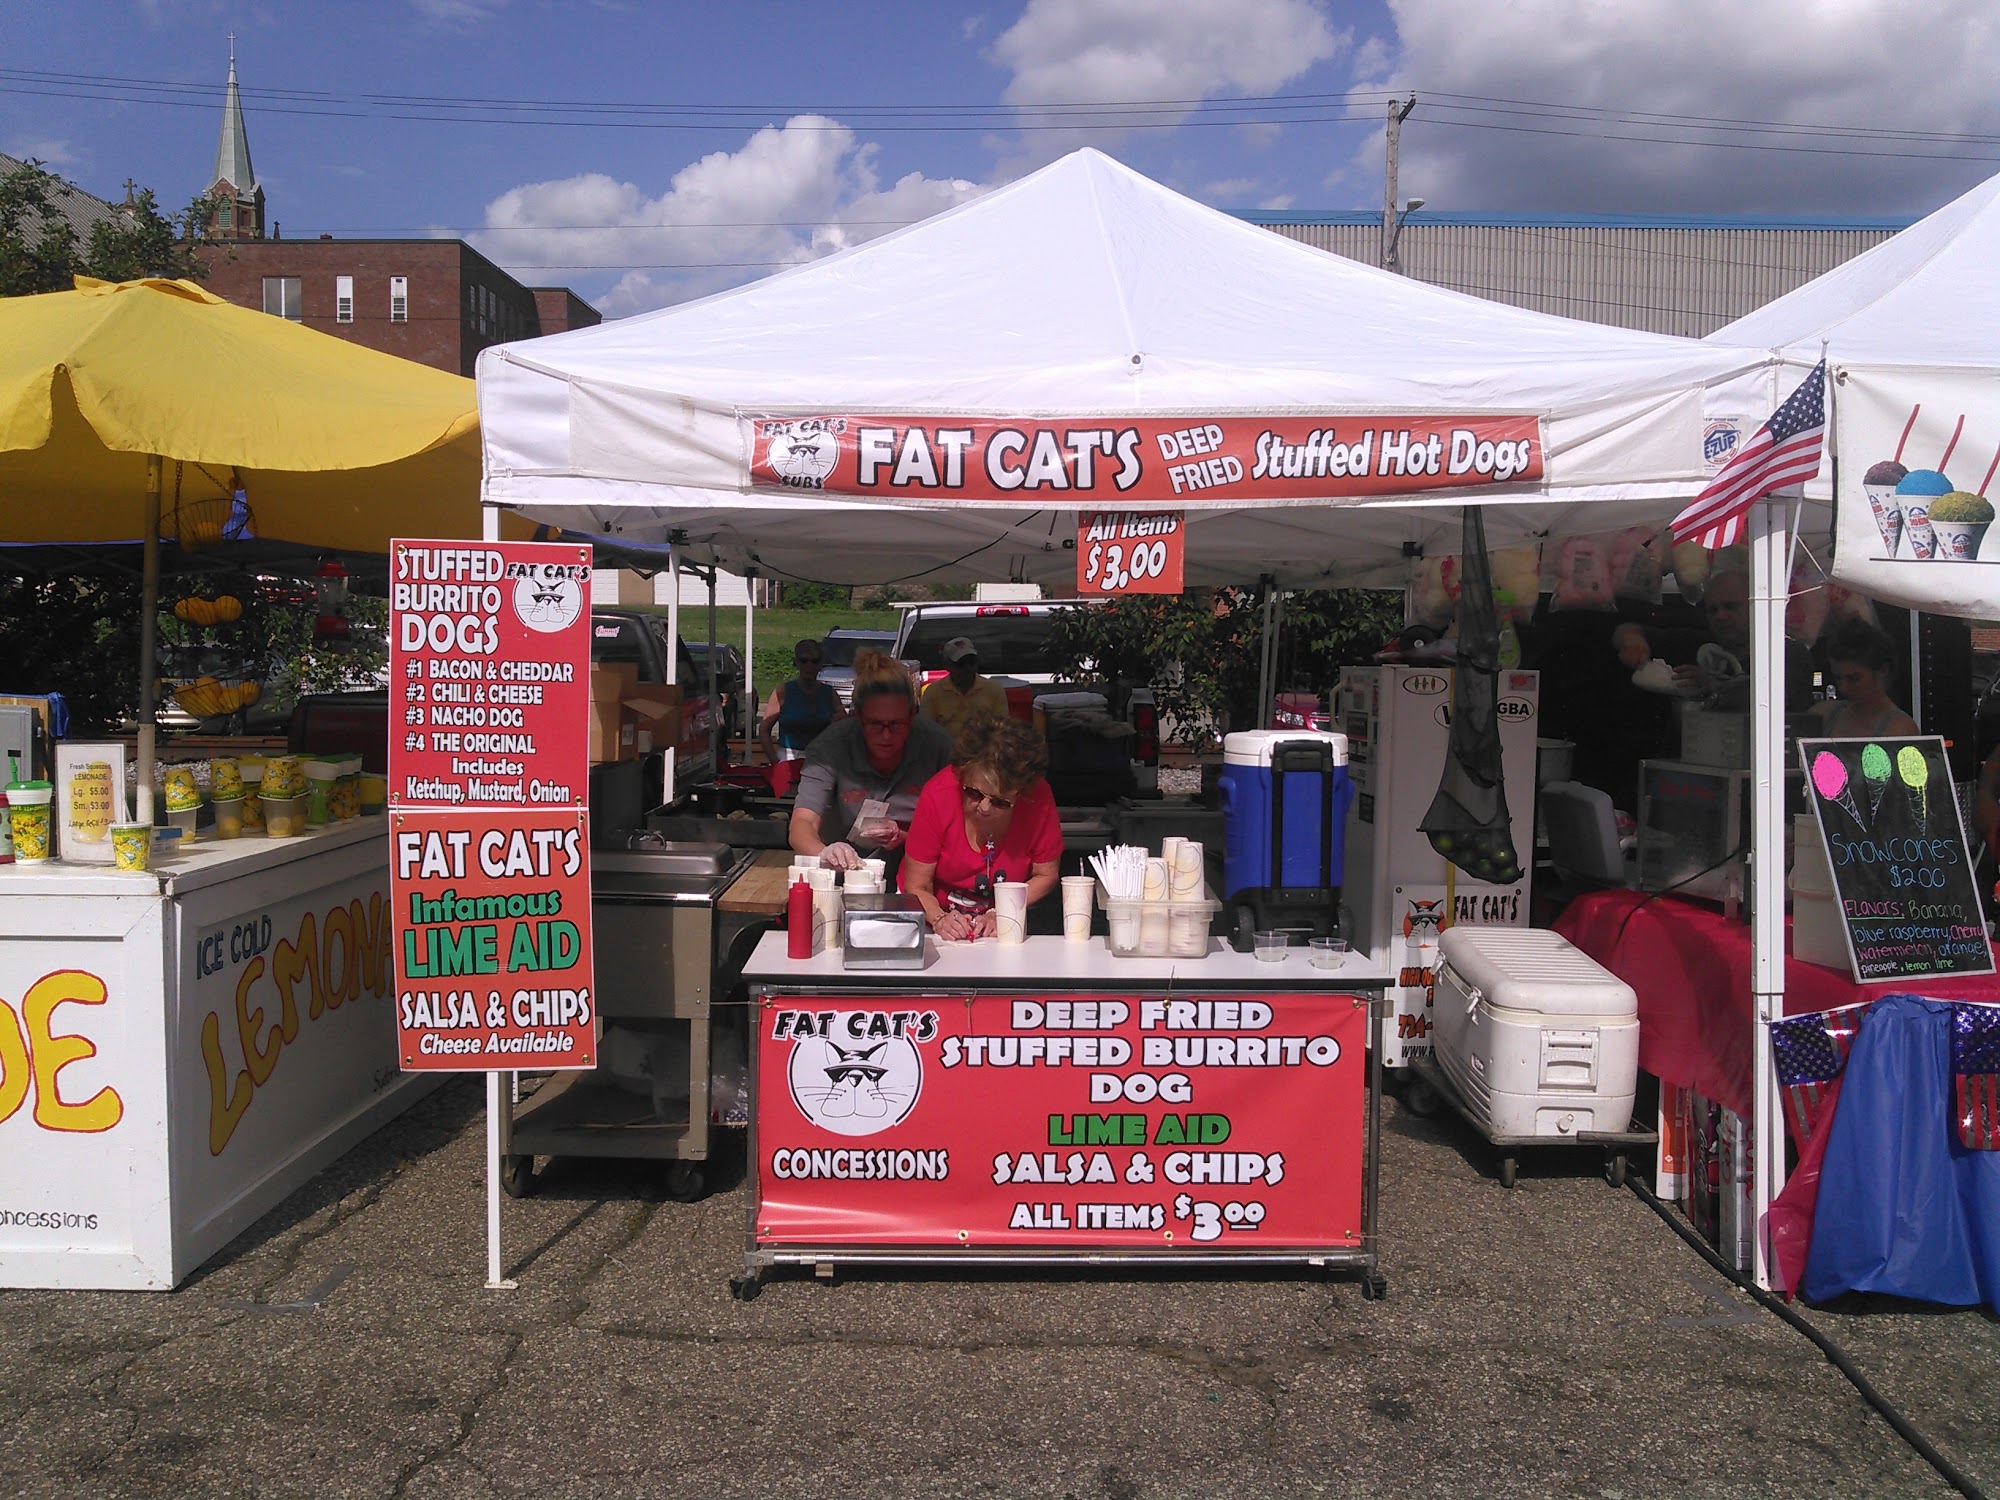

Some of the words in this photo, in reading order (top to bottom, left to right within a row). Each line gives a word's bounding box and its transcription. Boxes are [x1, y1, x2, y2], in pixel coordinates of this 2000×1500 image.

[763, 421, 794, 437] FAT
[800, 417, 848, 435] CAT'S
[1155, 423, 1224, 461] DEEP
[857, 427, 974, 488] FAT
[985, 427, 1142, 491] CAT'S
[1252, 428, 1374, 480] Stuffed
[1377, 429, 1442, 477] Hot
[1446, 429, 1530, 480] Dogs
[782, 475, 822, 489] SUBS
[1167, 455, 1243, 495] FRIED
[1085, 514, 1119, 542] All
[1120, 512, 1177, 539] Items
[398, 549, 504, 582] STUFFED
[507, 563, 537, 580] FAT
[543, 564, 591, 582] CAT'S
[394, 582, 502, 614] BURRITO
[401, 613, 499, 655] DOGS
[406, 659, 423, 679] #1
[429, 659, 482, 680] BACON
[485, 661, 497, 680] &
[500, 661, 574, 682] CHEDDAR
[405, 683, 425, 702] #2
[431, 683, 470, 703] CHILI
[474, 684, 485, 703] &
[488, 685, 543, 704] CHEESE
[1497, 702, 1530, 715] GBA
[405, 706, 424, 725] #3
[431, 706, 486, 726] NACHO
[489, 708, 523, 727] DOG
[405, 732, 425, 751] #4
[431, 732, 461, 752] THE
[464, 733, 537, 754] ORIGINAL
[452, 757, 524, 776] Includes
[89, 787, 109, 796] $5.00
[90, 801, 110, 810] $3.00
[406, 777, 465, 804] Ketchup,
[468, 778, 527, 804] Mustard,
[529, 779, 569, 803] Onion
[397, 830, 471, 879] FAT
[479, 828, 581, 878] CAT'S
[410, 889, 562, 924] Infamous
[1454, 895, 1477, 923] FAT
[1482, 895, 1518, 923] CAT'S
[196, 930, 224, 980] ICE
[230, 914, 272, 964] COLD
[404, 925, 499, 978] LIME
[508, 921, 581, 973] AID
[1852, 925, 1885, 943] blue
[1905, 960, 1931, 972] lemon
[1935, 958, 1954, 969] lime
[401, 990, 480, 1030] SALSA
[485, 990, 506, 1028] &
[511, 987, 591, 1028] CHIPS
[1011, 1000, 1129, 1031] DEEP
[1139, 1000, 1274, 1031] FRIED
[772, 1009, 838, 1041] FAT
[846, 1010, 940, 1042] CAT'S
[420, 1033, 482, 1055] Cheese
[485, 1031, 574, 1054] Available
[940, 1035, 1132, 1068] STUFFED
[1141, 1035, 1341, 1067] BURRITO
[1090, 1072, 1192, 1103] DOG
[1048, 1113, 1147, 1146] LIME
[1154, 1113, 1231, 1146] AID
[772, 1148, 949, 1181] CONCESSIONS
[991, 1151, 1116, 1186] SALSA
[1125, 1152, 1156, 1184] &
[1163, 1151, 1285, 1187] CHIPS
[1008, 1201, 1071, 1230] ALL
[1076, 1201, 1166, 1232] ITEMS
